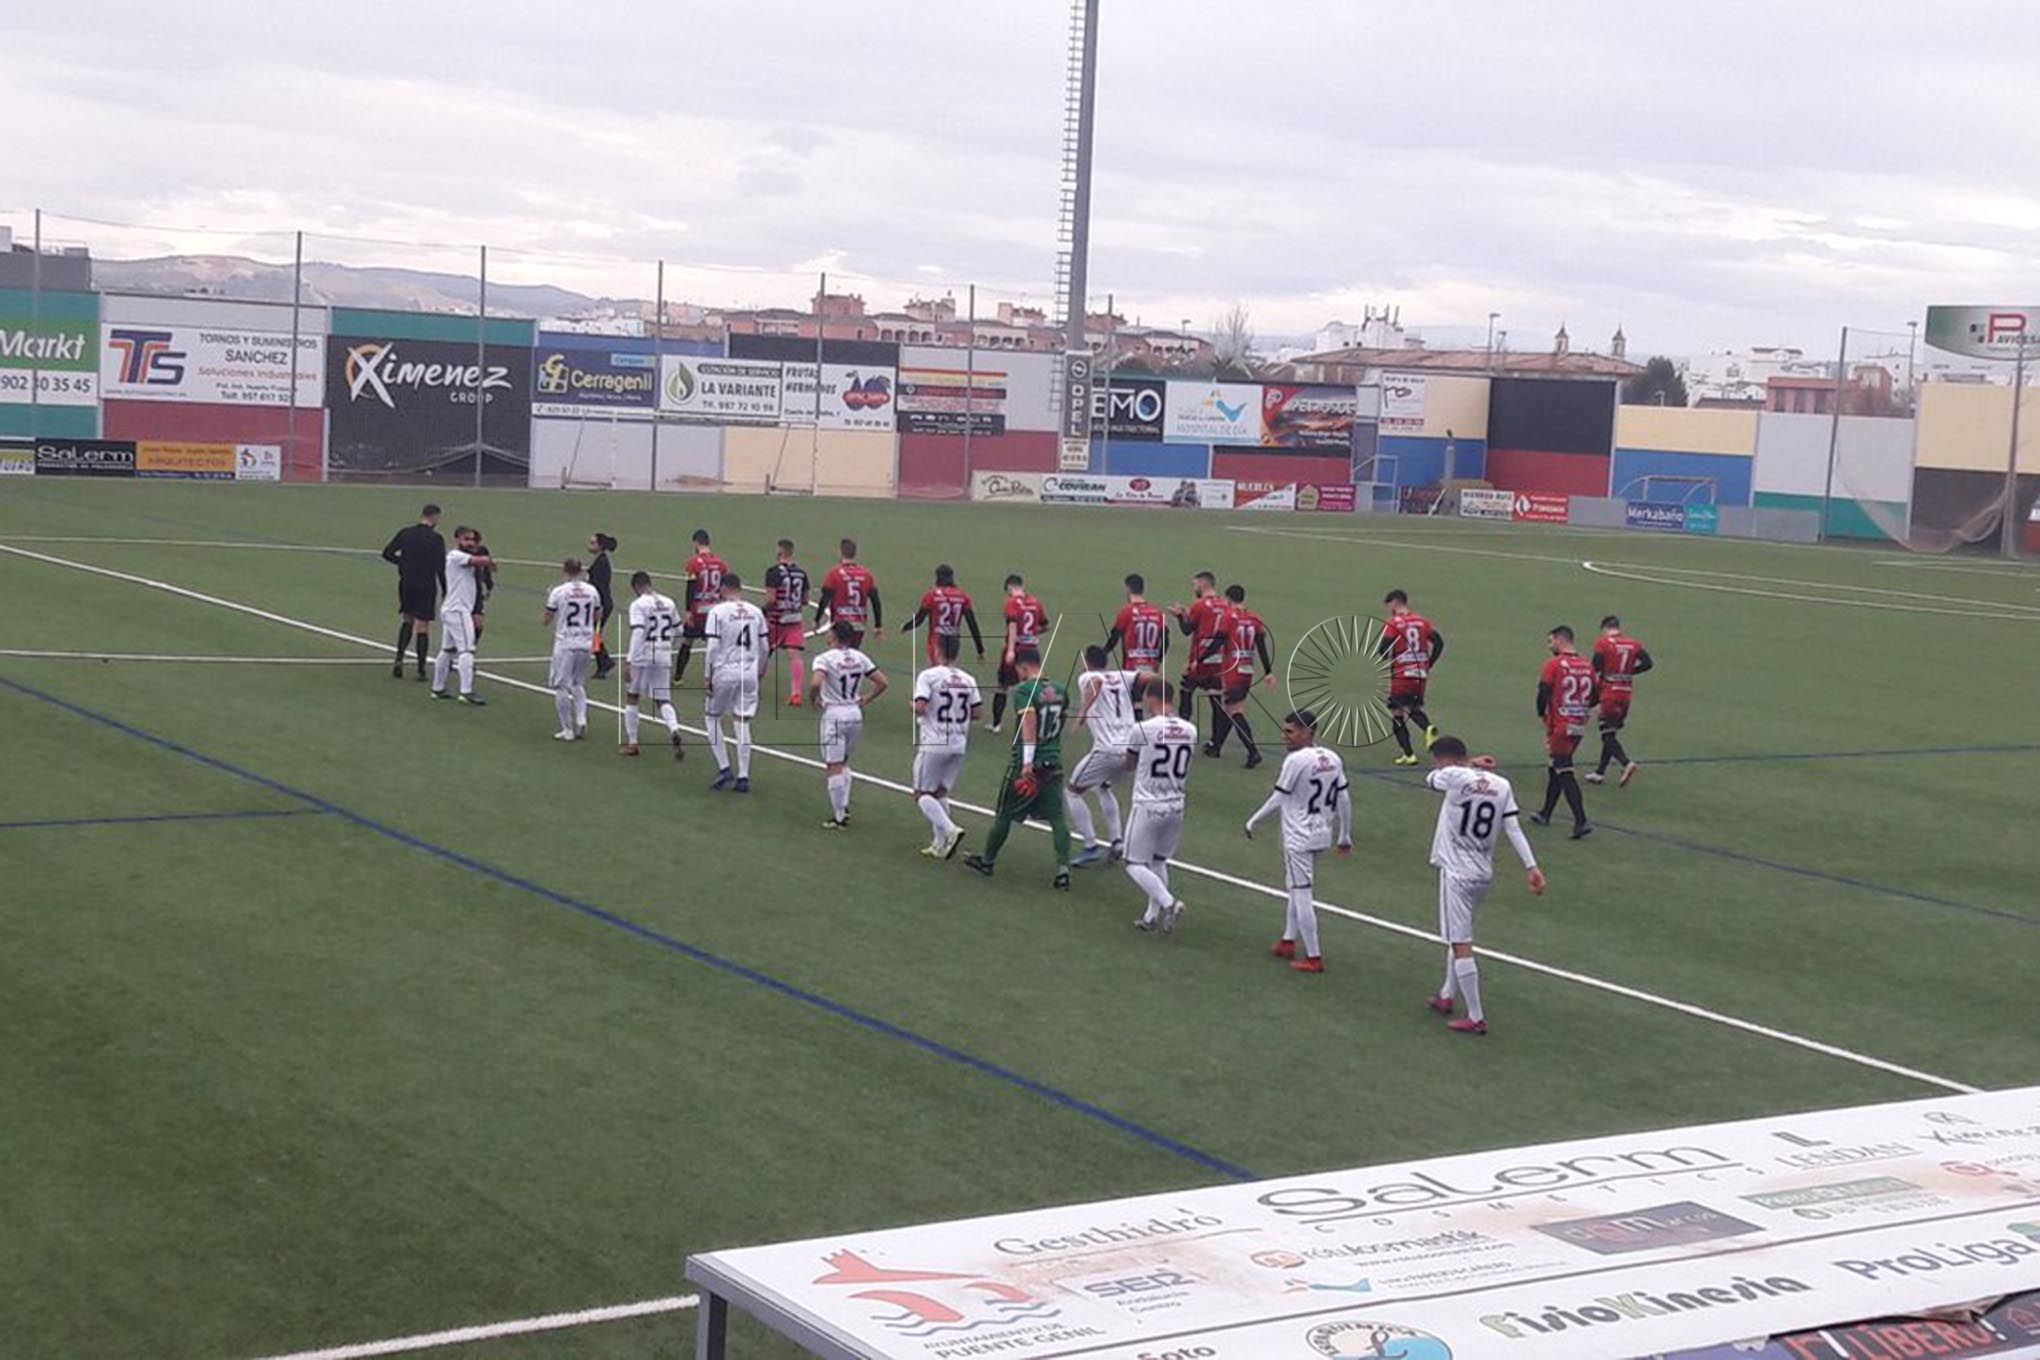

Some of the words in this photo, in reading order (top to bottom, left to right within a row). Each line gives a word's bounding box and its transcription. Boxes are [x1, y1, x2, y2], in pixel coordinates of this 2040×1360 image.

[225, 349, 288, 365] SANCHEZ
[1, 375, 28, 390] 902
[52, 377, 70, 392] 35
[701, 381, 716, 396] LA
[719, 382, 776, 398] VARIANTE
[1071, 384, 1085, 436] OPEL
[847, 581, 861, 606] 5
[566, 602, 591, 627] 21
[646, 614, 673, 641] 22
[1023, 611, 1034, 635] 2
[736, 623, 750, 648] 4
[1135, 621, 1158, 649] 10
[1406, 627, 1420, 652] 8
[838, 673, 862, 699] 17
[1561, 676, 1593, 705] 22
[937, 691, 969, 723] 23
[1038, 705, 1062, 739] 13
[1151, 743, 1192, 779] 20
[1308, 776, 1339, 814] 24
[1459, 800, 1496, 840] 18
[1833, 1239, 2039, 1281] ProLiga
